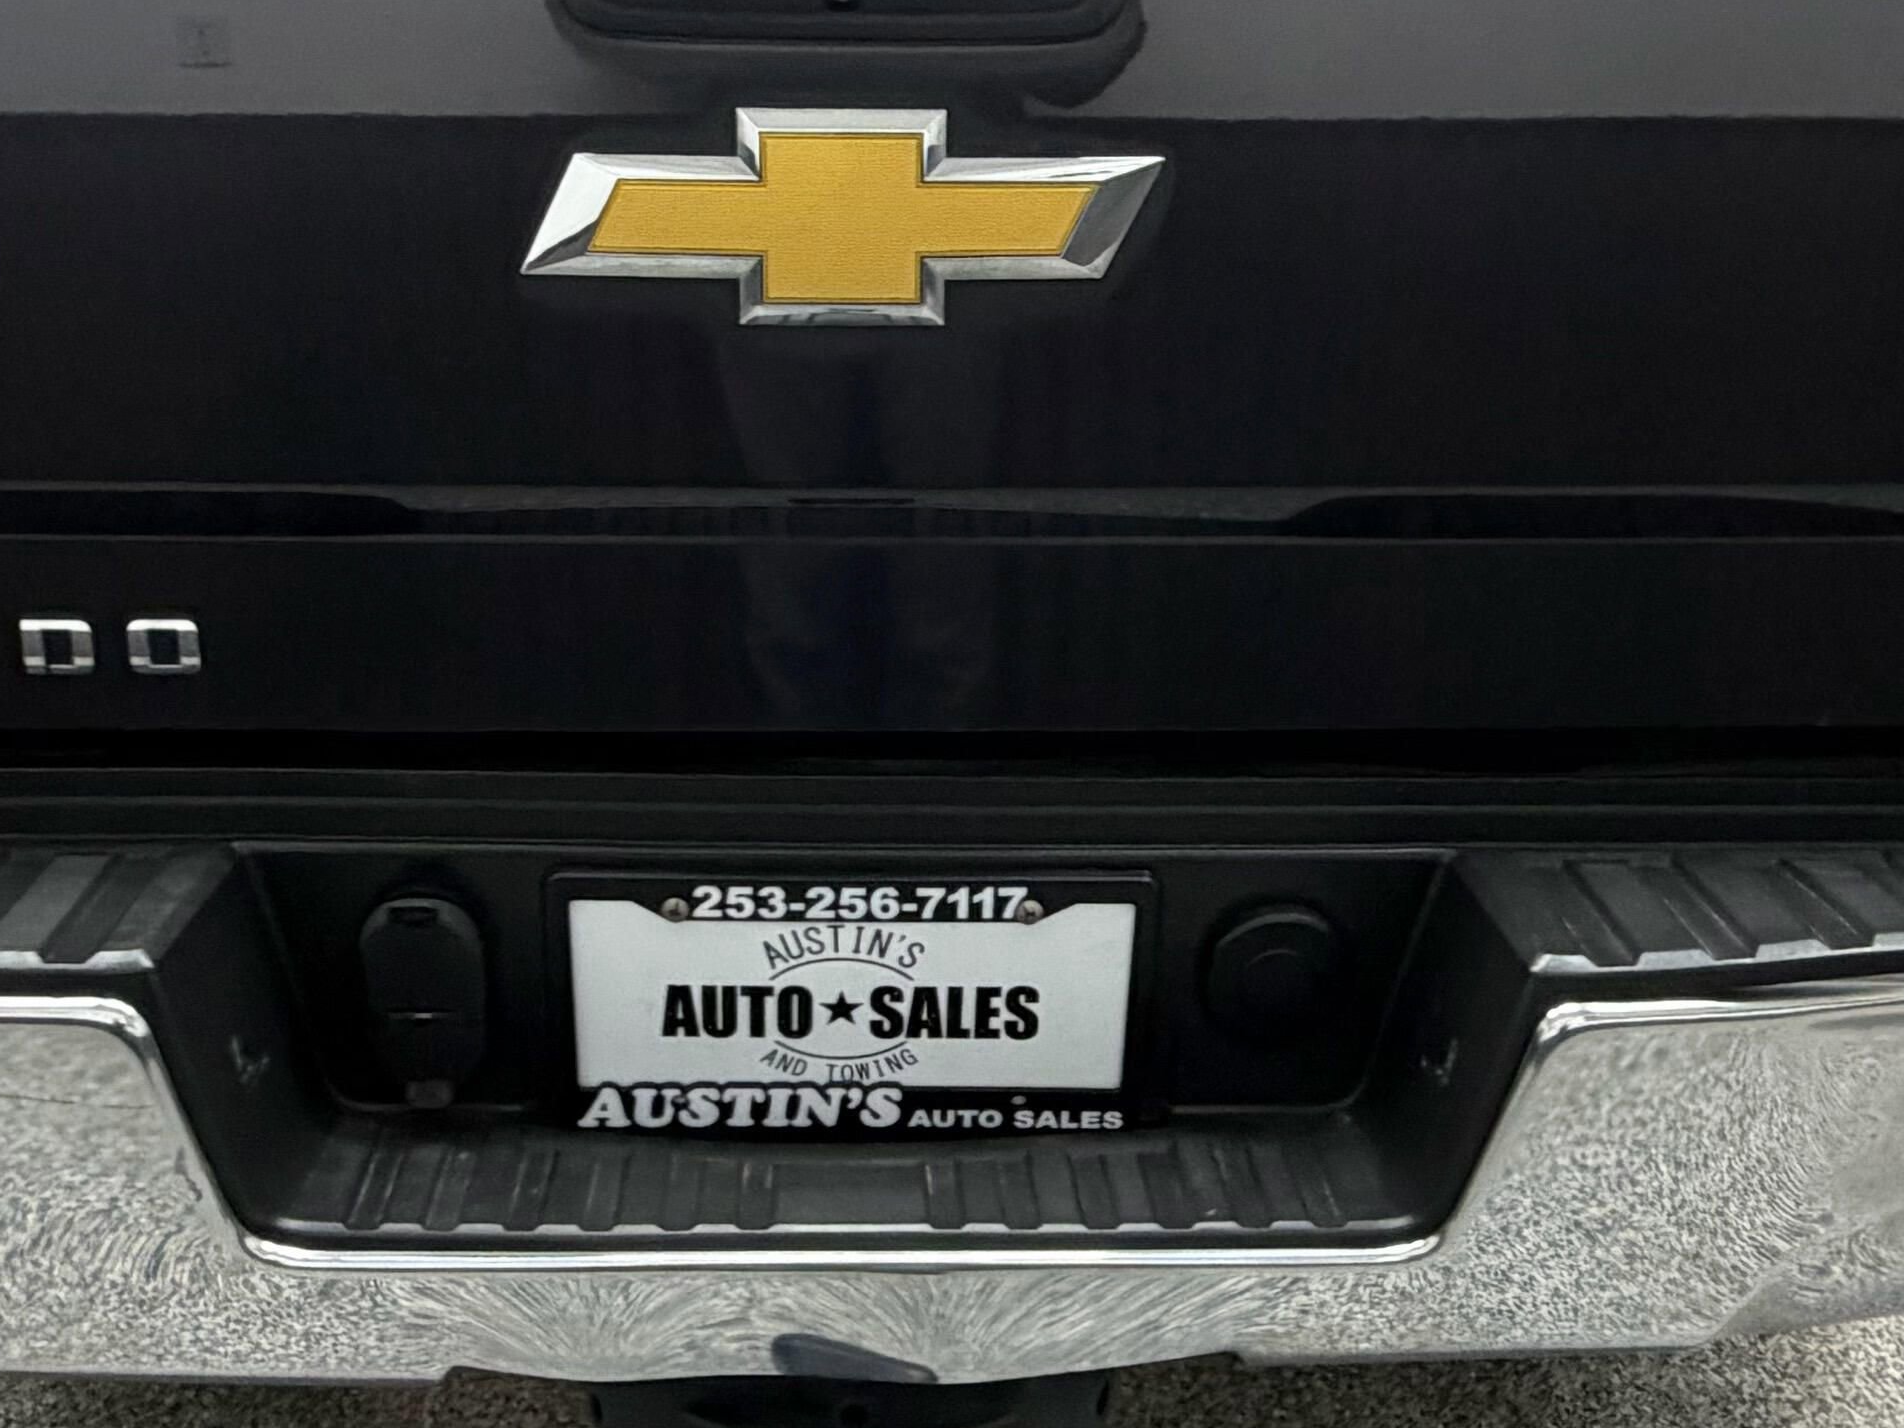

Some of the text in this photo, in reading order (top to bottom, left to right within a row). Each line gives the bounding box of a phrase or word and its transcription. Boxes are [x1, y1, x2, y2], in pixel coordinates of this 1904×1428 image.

[692, 885, 1028, 920] 253-256-7117
[762, 924, 925, 970] AUSTIN'S
[660, 985, 1040, 1040] AUTO SALES
[759, 1048, 920, 1083] AND TOWING
[577, 1086, 1124, 1130] AUSTIN'S AUTO SALES
